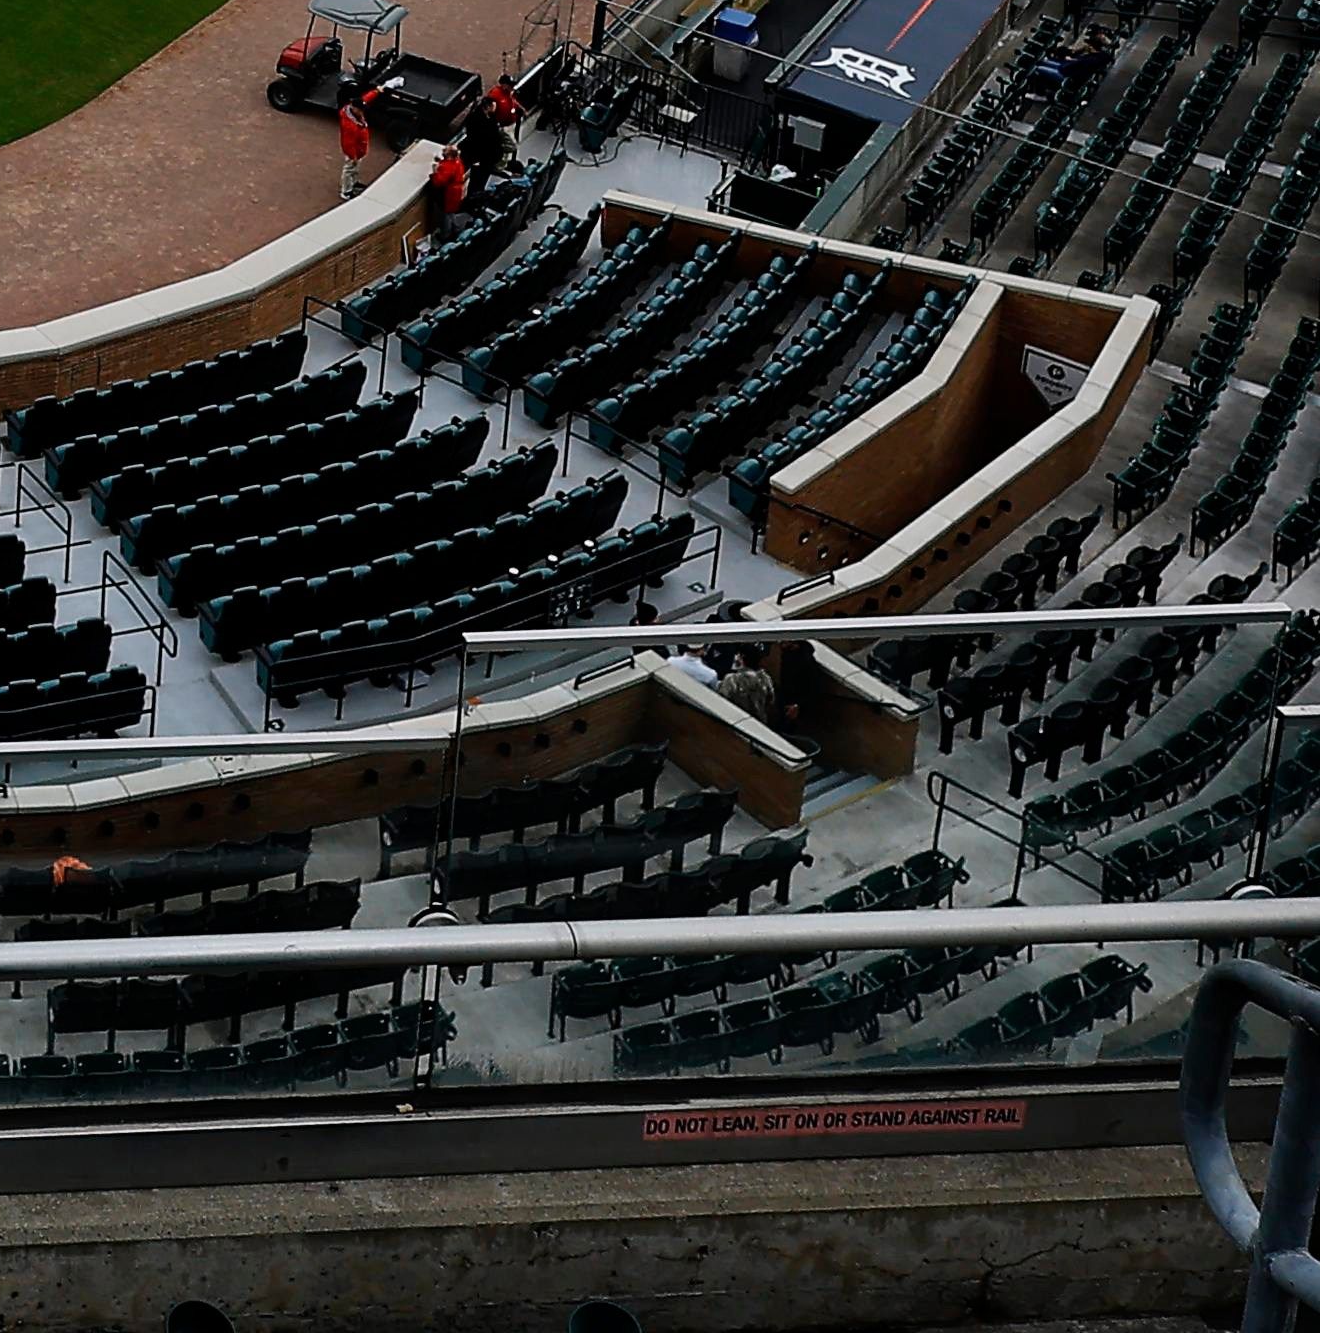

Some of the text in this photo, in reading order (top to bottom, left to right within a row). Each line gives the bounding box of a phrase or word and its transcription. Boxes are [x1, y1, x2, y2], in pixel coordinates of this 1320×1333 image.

[645, 1108, 1021, 1135] DO NOT LEAN, SIT ON OR STAND AGAINST RAIL
